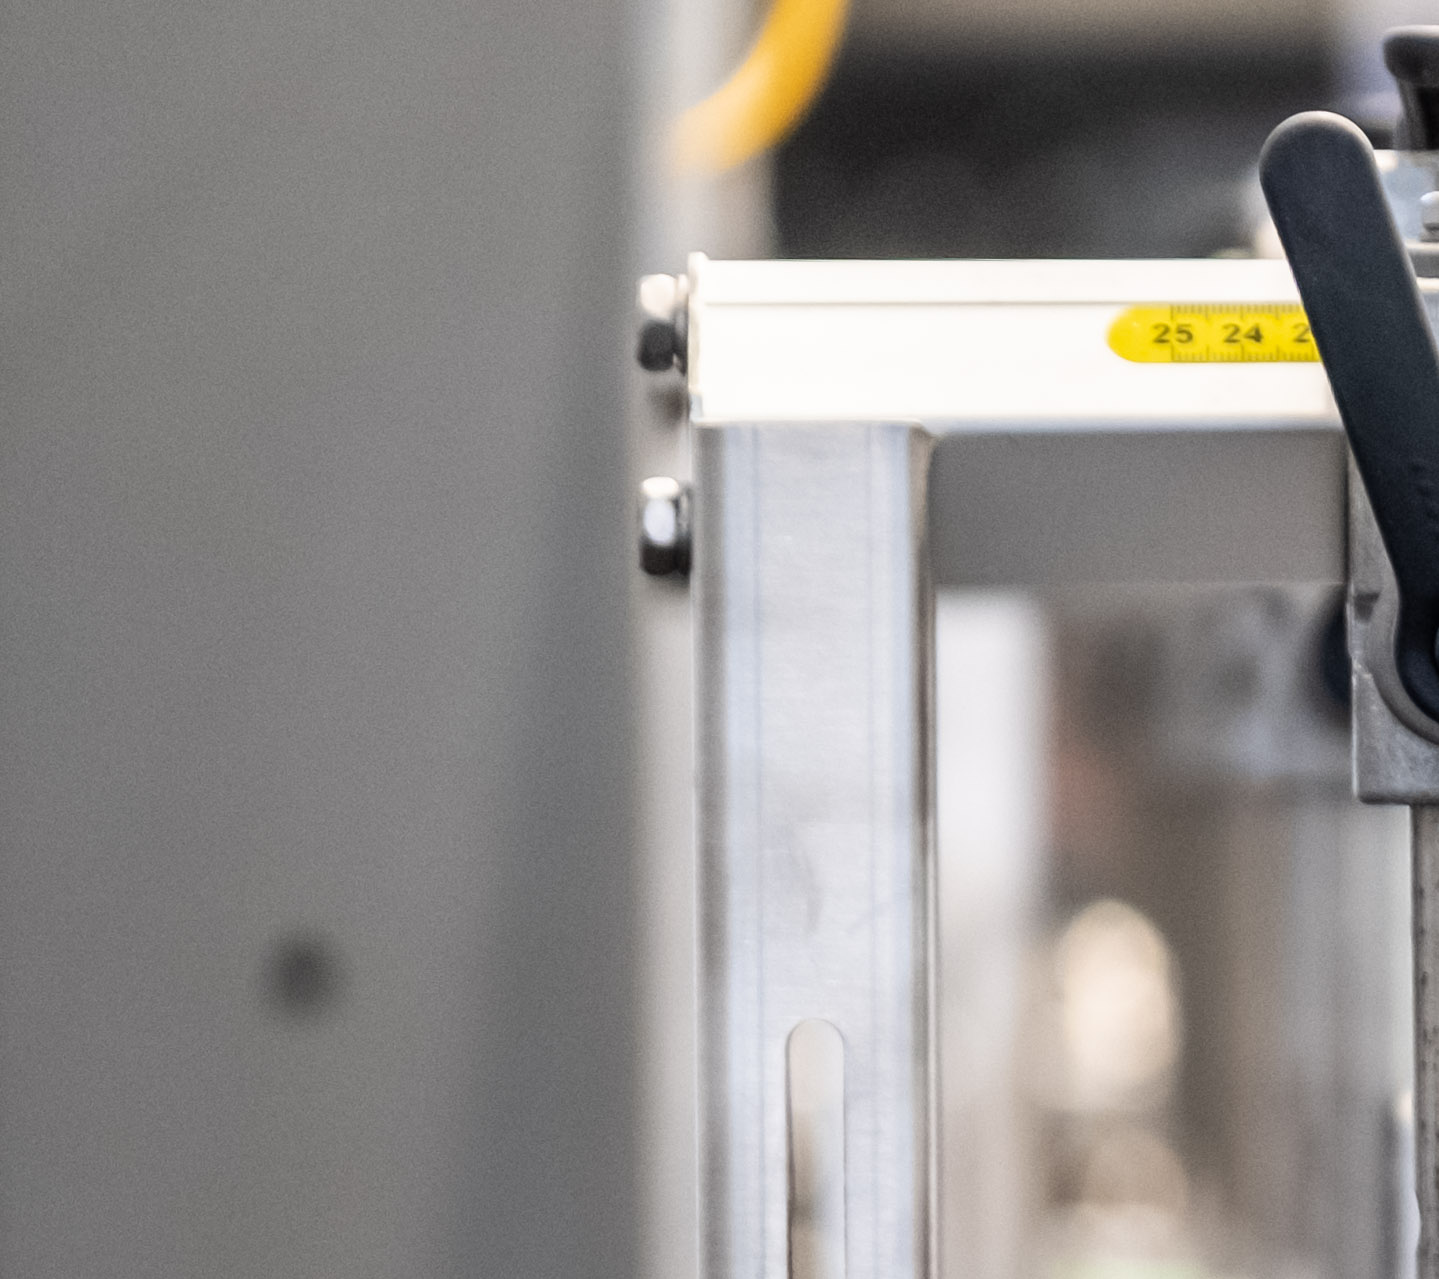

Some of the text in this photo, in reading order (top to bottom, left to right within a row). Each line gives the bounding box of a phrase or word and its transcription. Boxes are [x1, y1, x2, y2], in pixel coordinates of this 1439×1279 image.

[1152, 323, 1194, 344] 25
[1222, 323, 1264, 344] 24
[1292, 323, 1313, 344] 2
